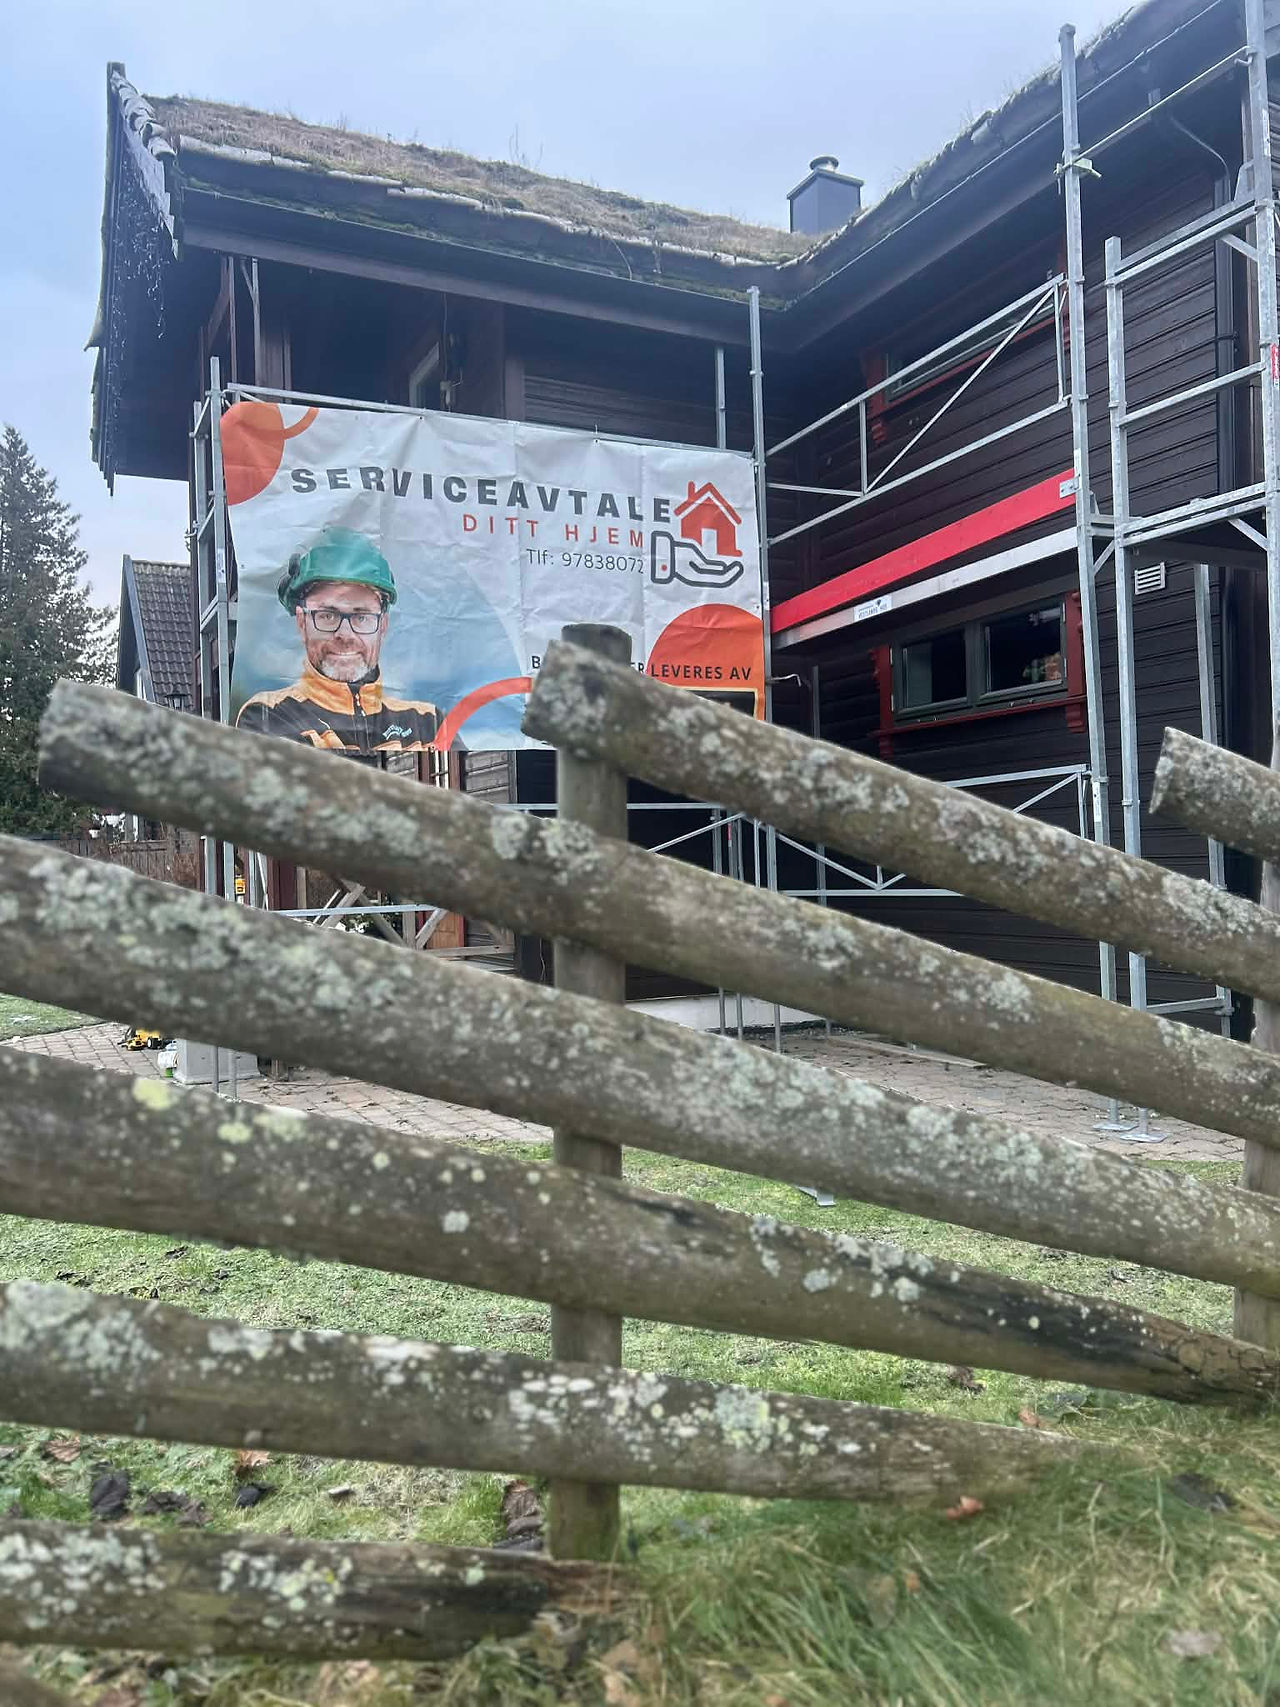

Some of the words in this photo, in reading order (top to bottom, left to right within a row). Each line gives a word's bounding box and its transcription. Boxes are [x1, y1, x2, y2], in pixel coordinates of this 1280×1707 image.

[291, 466, 671, 523] SERVICEAVTALE
[463, 514, 538, 537] DITT
[565, 523, 643, 548] HJEM
[526, 548, 554, 565] Tlf:
[561, 552, 644, 574] 97838072
[651, 664, 723, 680] LEVERES
[729, 666, 752, 681] AV
